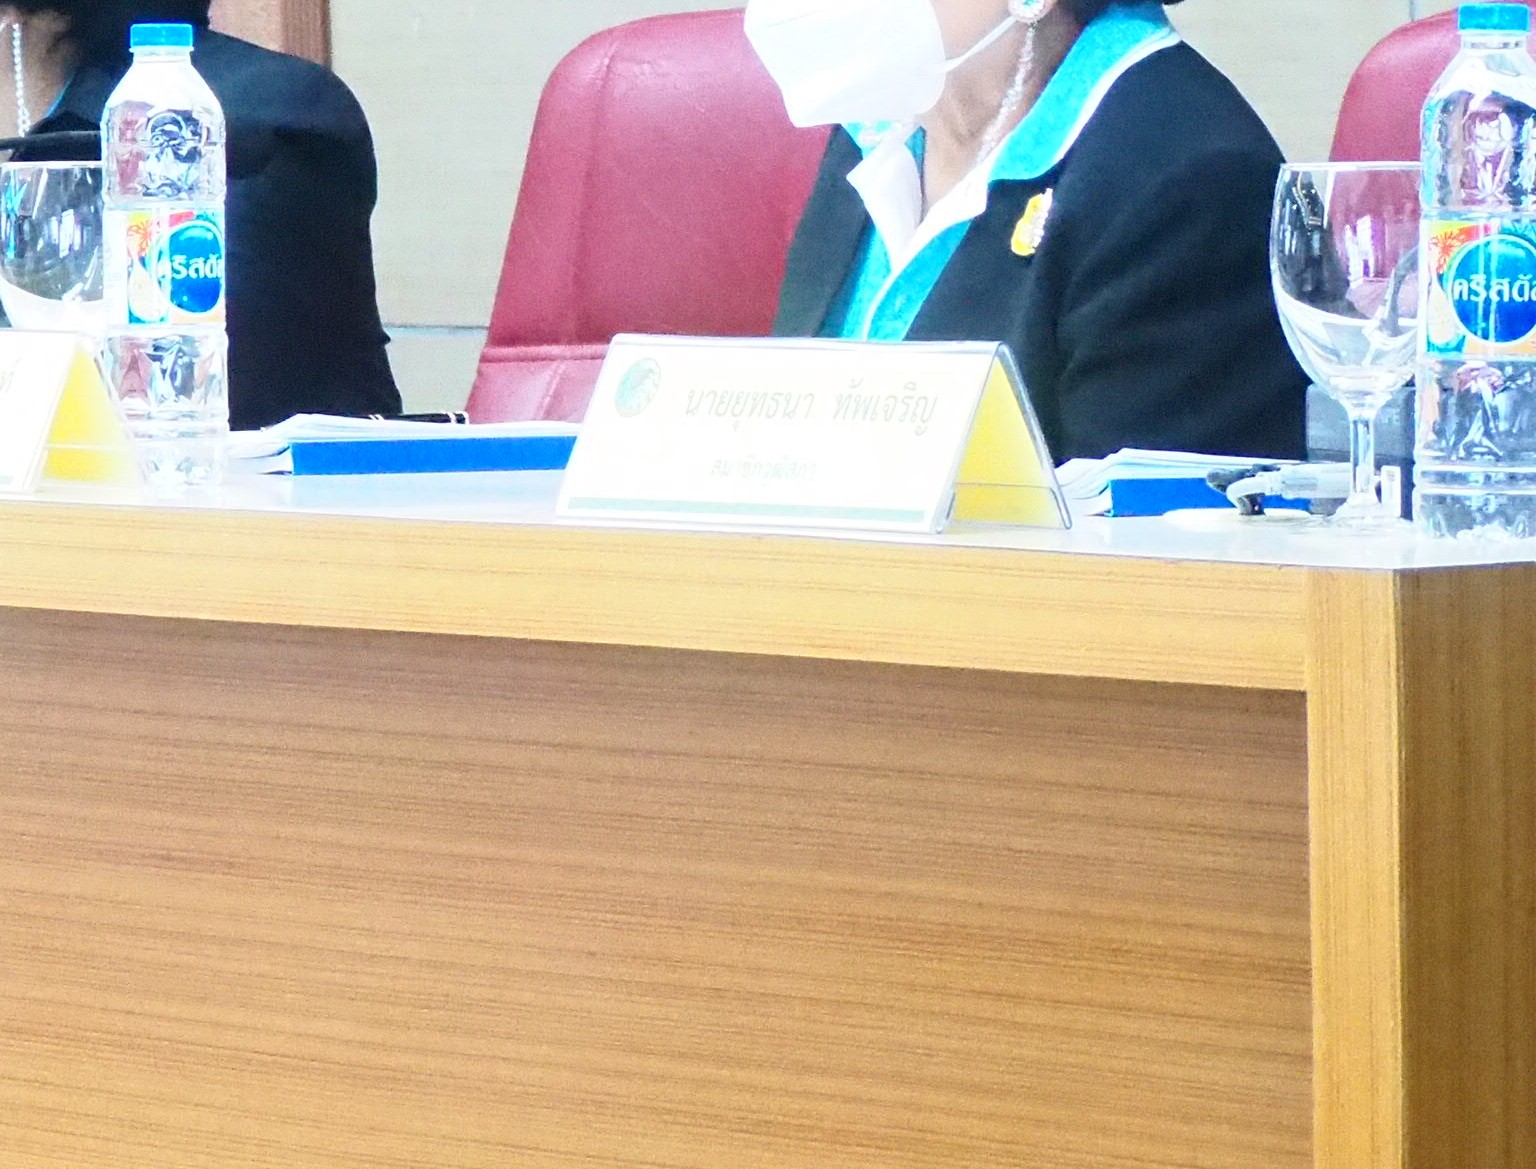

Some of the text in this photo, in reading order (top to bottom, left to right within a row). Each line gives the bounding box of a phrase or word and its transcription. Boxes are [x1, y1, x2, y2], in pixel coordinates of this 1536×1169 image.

[158, 254, 224, 280] ริสตั
[685, 378, 939, 437] นายยุทธนา ทัพเจริญ
